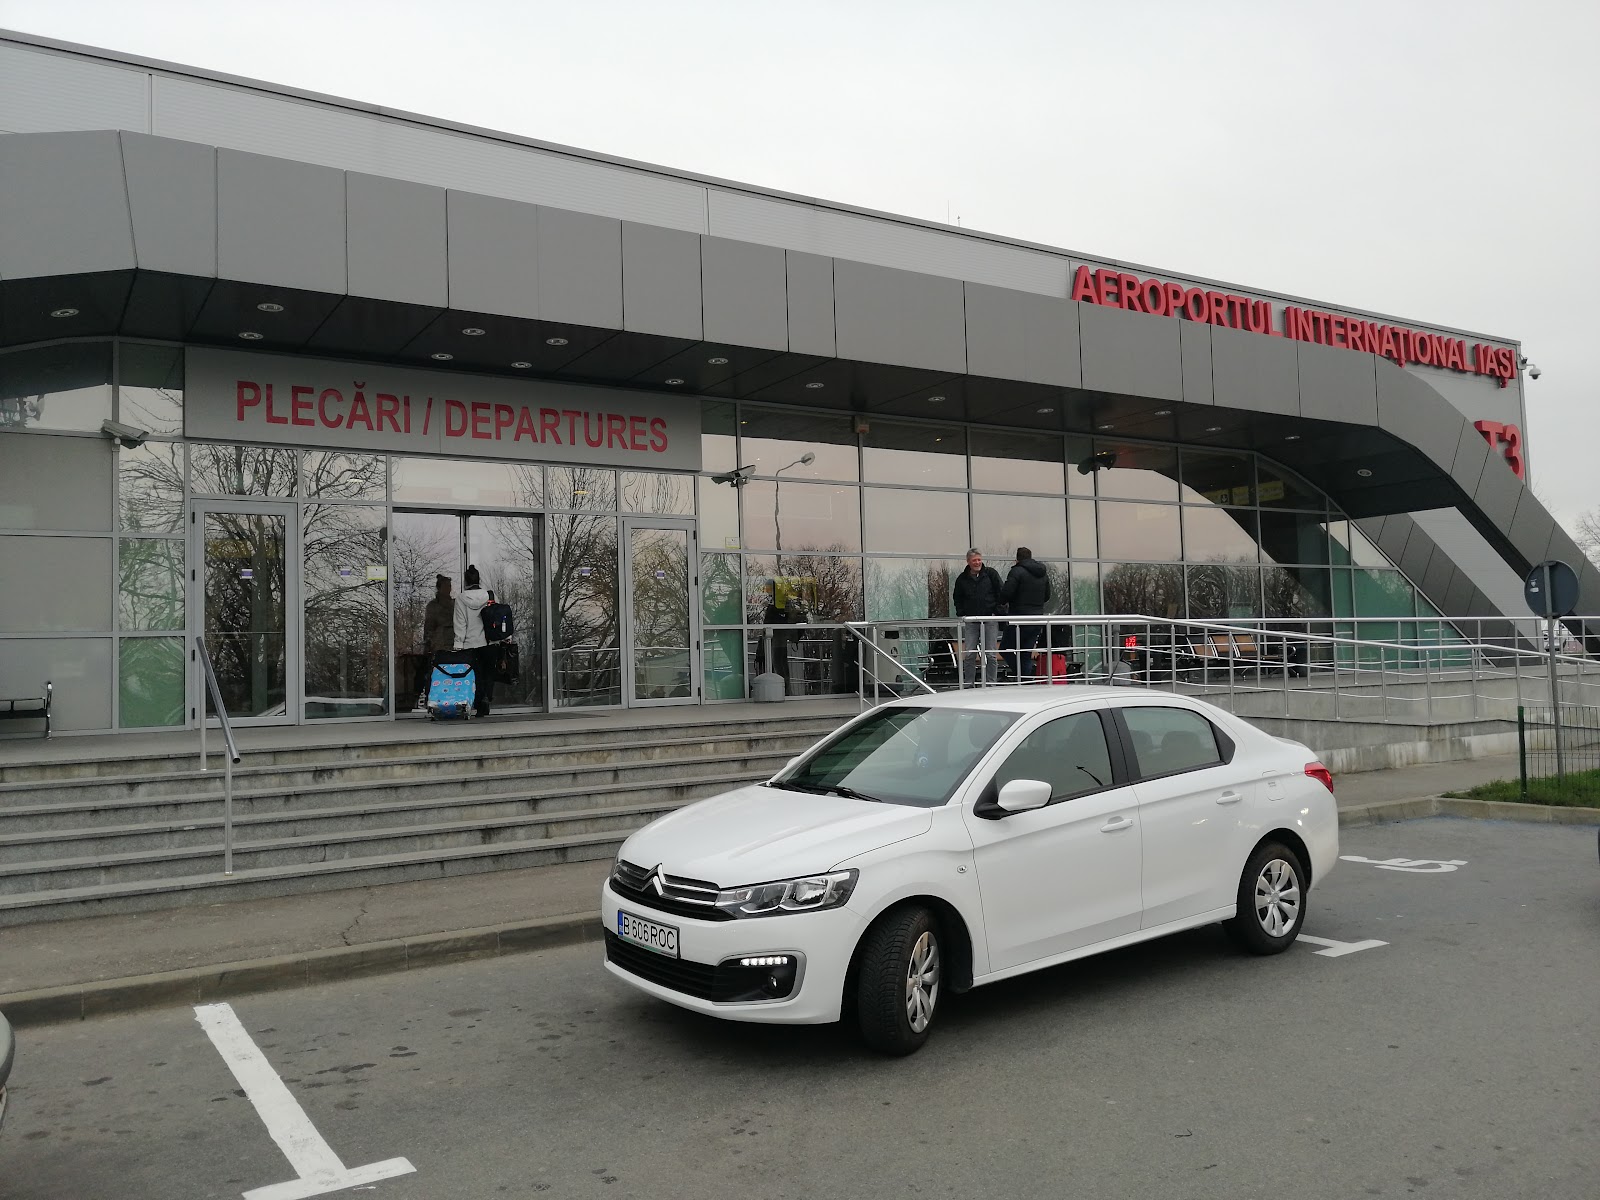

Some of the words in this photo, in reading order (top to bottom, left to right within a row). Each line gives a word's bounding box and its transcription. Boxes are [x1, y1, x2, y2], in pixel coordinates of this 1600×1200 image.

[1071, 265, 1283, 337] AEROPORTUL
[236, 380, 411, 434] PLECĂRI
[445, 399, 668, 453] DEPARTURES
[1474, 419, 1525, 482] T3
